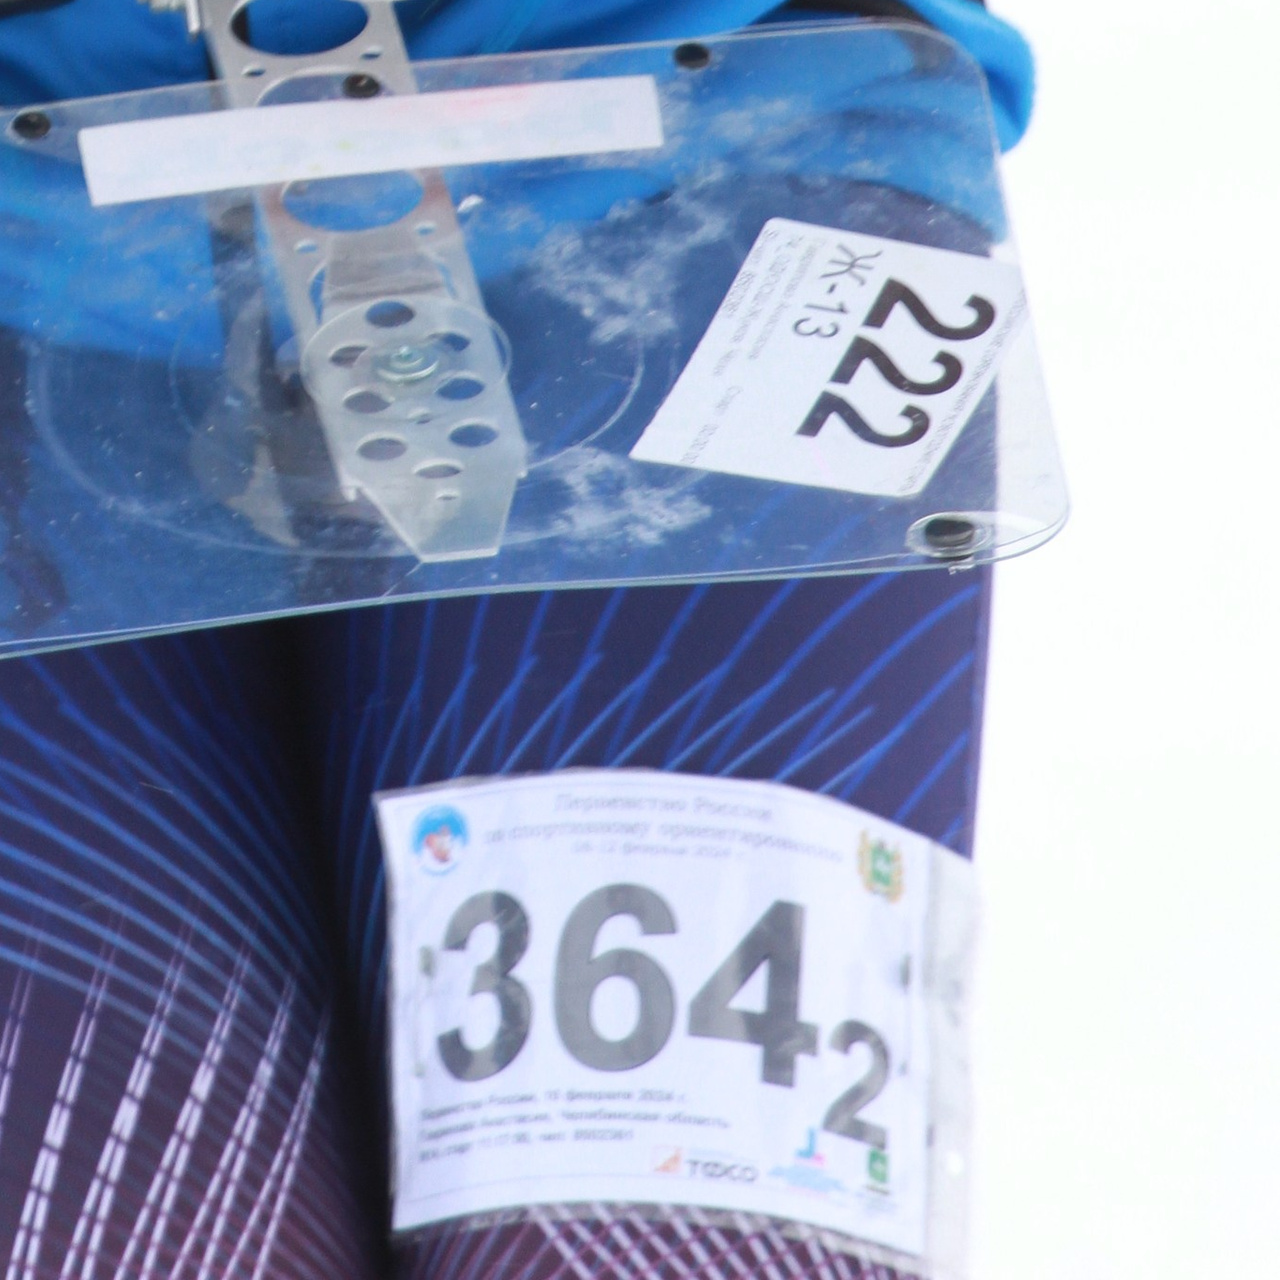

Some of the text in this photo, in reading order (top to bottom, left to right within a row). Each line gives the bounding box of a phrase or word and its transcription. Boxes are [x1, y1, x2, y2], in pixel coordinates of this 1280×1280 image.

[793, 243, 883, 339] Ж-13
[795, 277, 996, 449] 222
[437, 882, 820, 1088] 364
[823, 1018, 890, 1149] 2
